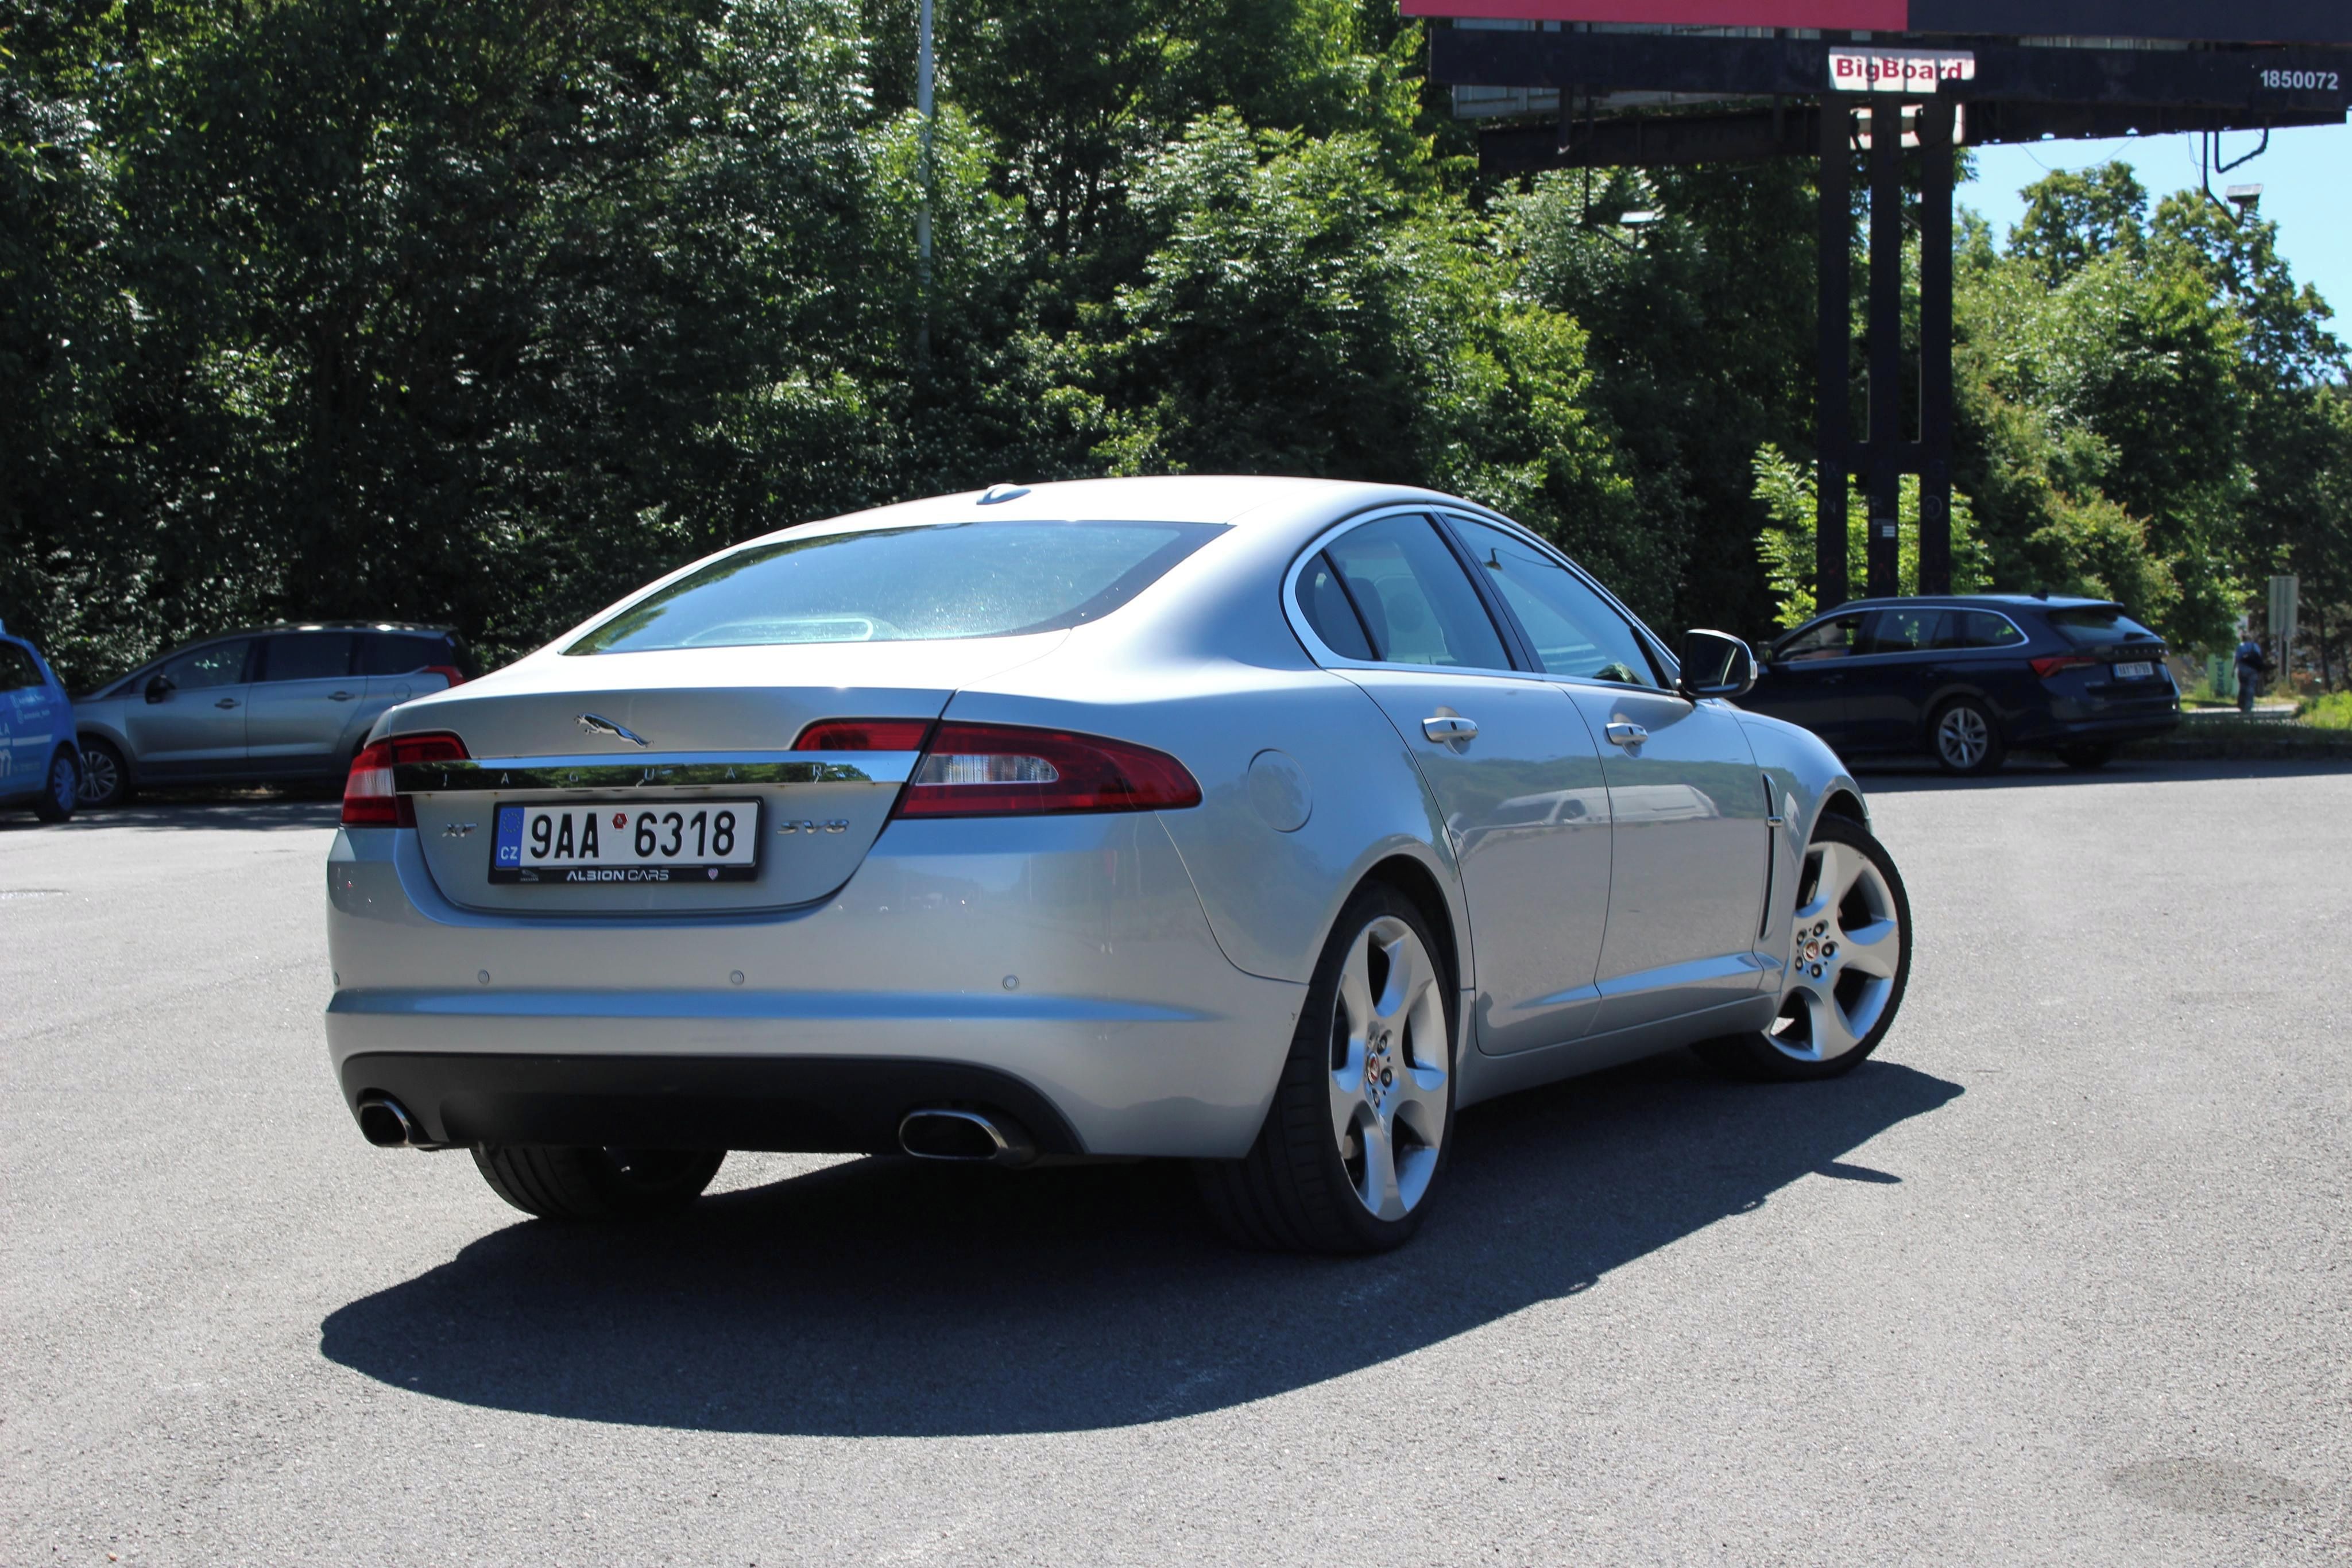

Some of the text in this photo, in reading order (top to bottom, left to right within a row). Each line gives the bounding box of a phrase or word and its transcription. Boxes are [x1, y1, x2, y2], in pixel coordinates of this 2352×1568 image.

[1836, 57, 1963, 82] BigBoard
[2260, 69, 2338, 90] 1850072
[530, 810, 736, 859] 9AA 6318
[776, 819, 849, 834] SV8
[500, 846, 518, 860] CZ
[566, 869, 669, 881] ALBION CARS
